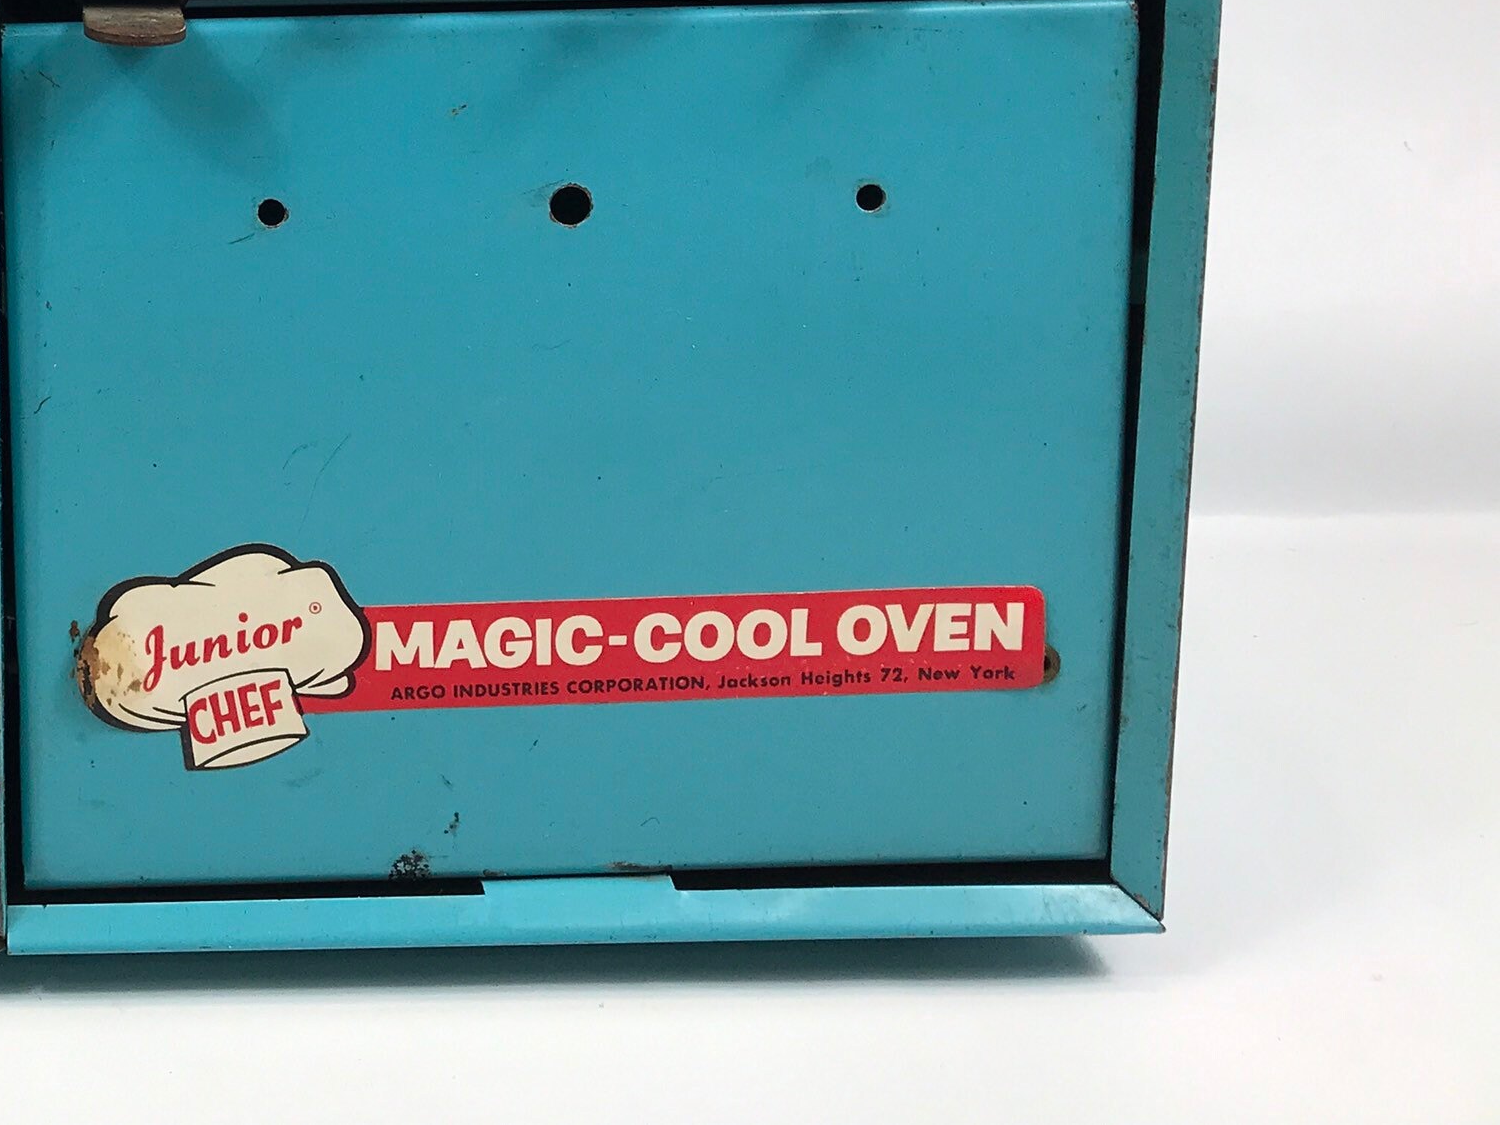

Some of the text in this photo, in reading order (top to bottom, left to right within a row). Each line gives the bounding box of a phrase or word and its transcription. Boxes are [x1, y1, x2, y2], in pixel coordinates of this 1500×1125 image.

[143, 612, 304, 692] Junior
[374, 601, 1025, 672] MAGIC-COOL OVEN
[187, 679, 284, 745] CHEF
[390, 664, 1016, 701] ARGO INDUSTRIES CORPORATION, Jackson Heights 72, New York
